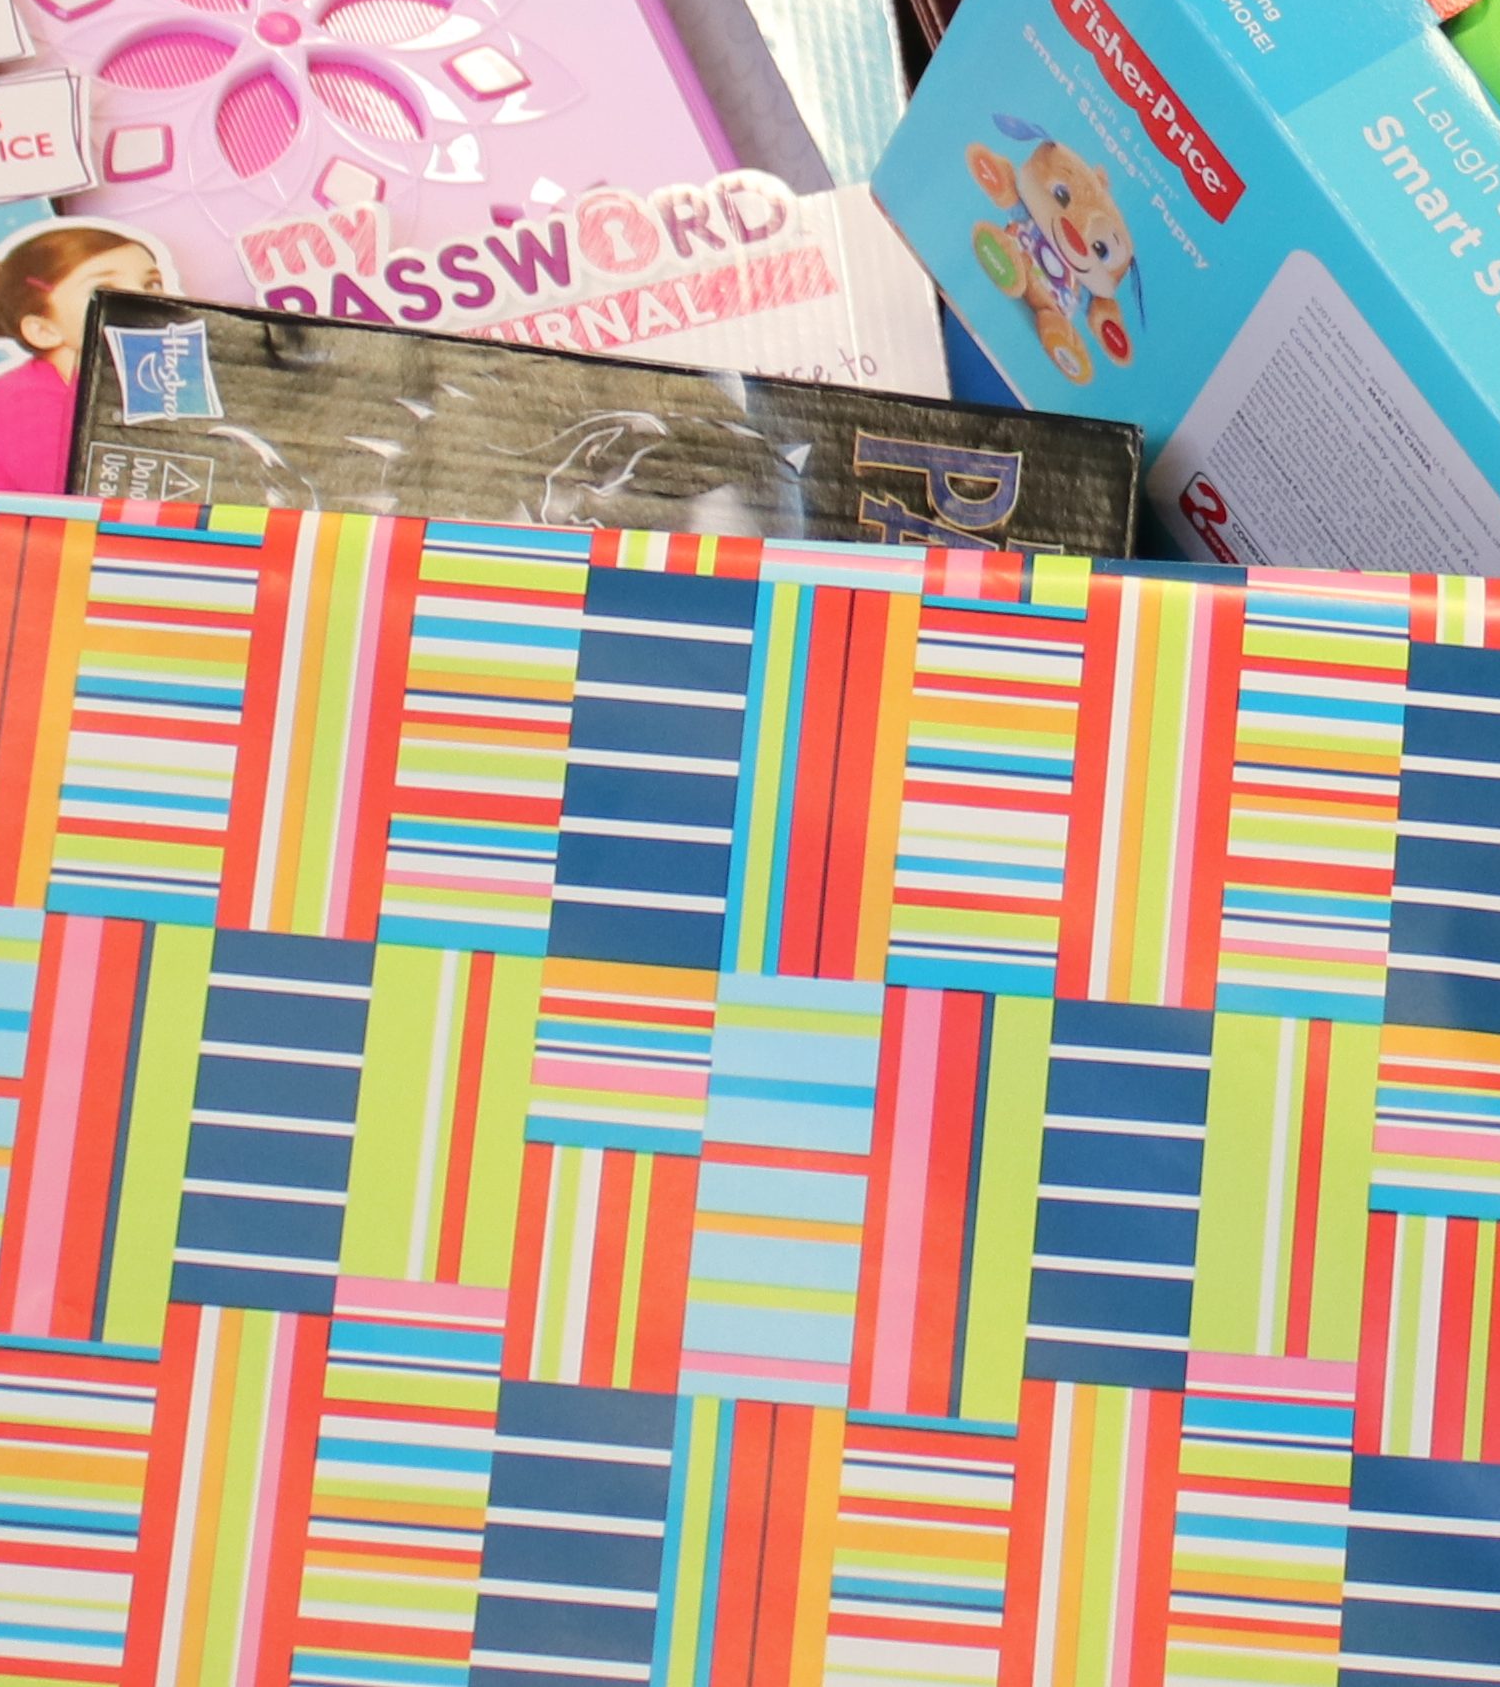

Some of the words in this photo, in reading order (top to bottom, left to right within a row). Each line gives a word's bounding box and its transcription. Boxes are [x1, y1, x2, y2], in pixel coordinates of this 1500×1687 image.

[1022, 23, 1076, 97] Smart
[1150, 194, 1209, 270] Puppy
[1361, 114, 1483, 260] Smart
[160, 326, 190, 422] Hasbro
[838, 347, 878, 383] to
[102, 453, 128, 481] Use
[132, 457, 158, 480] Do
